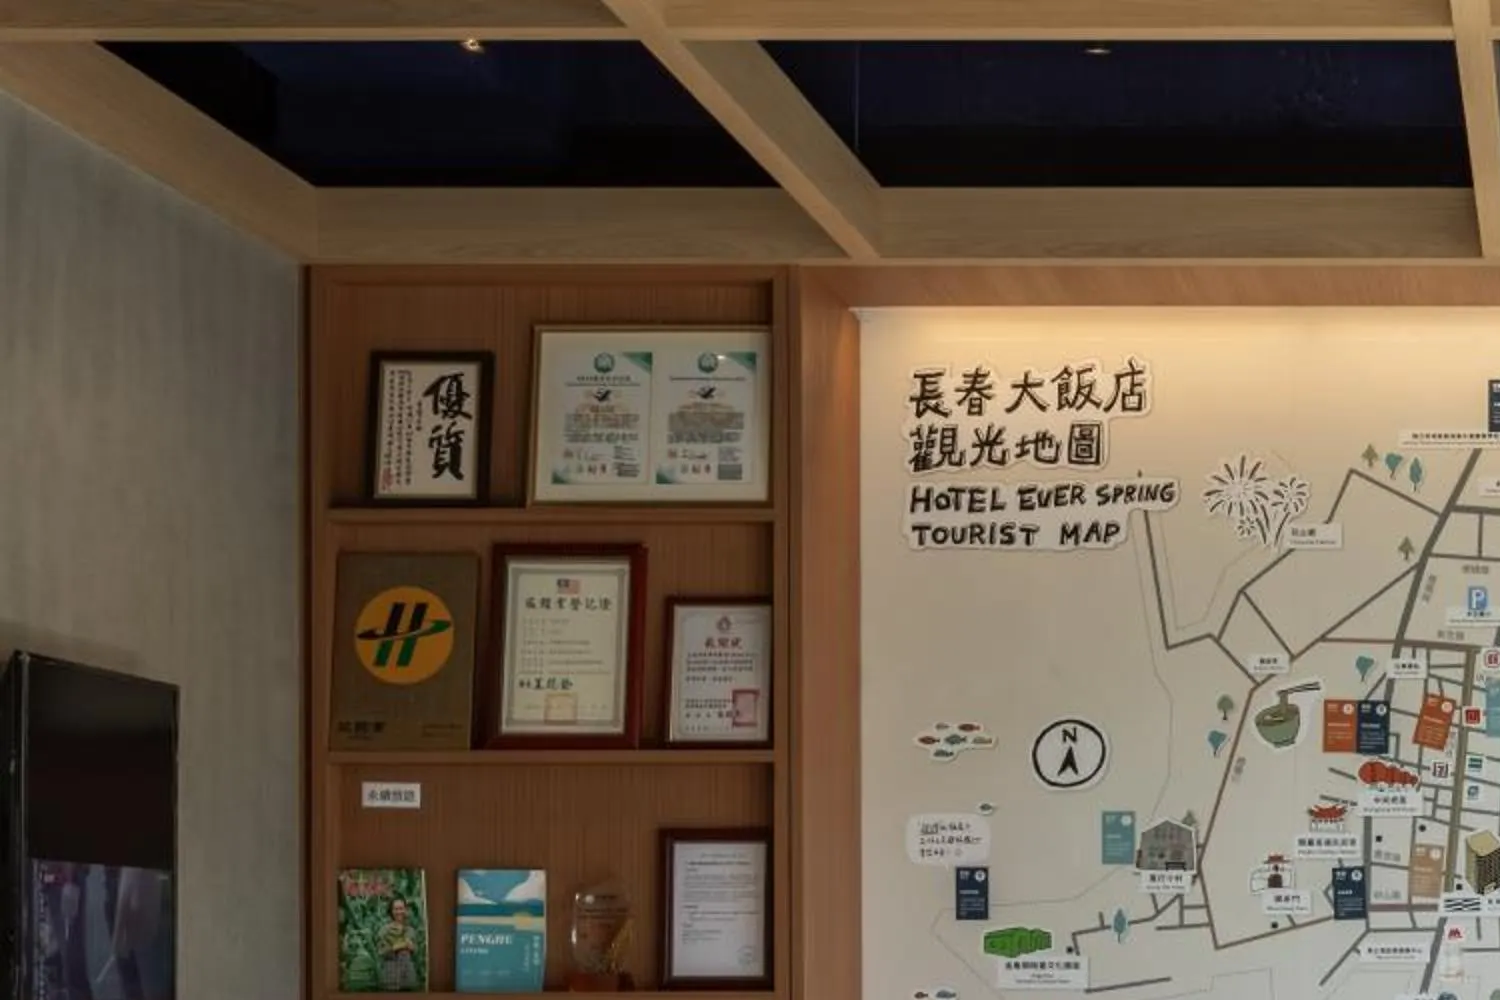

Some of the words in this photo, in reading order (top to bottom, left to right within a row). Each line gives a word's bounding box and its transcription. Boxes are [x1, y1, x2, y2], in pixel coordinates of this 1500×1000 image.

[909, 357, 1147, 418] 長春大飯店
[423, 372, 473, 481] 優質
[908, 423, 1102, 473] 觀光地圖
[909, 484, 1007, 514] HOTEL
[1016, 482, 1086, 511] EVER
[1095, 480, 1176, 507] SPRING
[911, 522, 1040, 547] TOURIST
[1058, 521, 1121, 547] MAP
[1062, 727, 1078, 743] N
